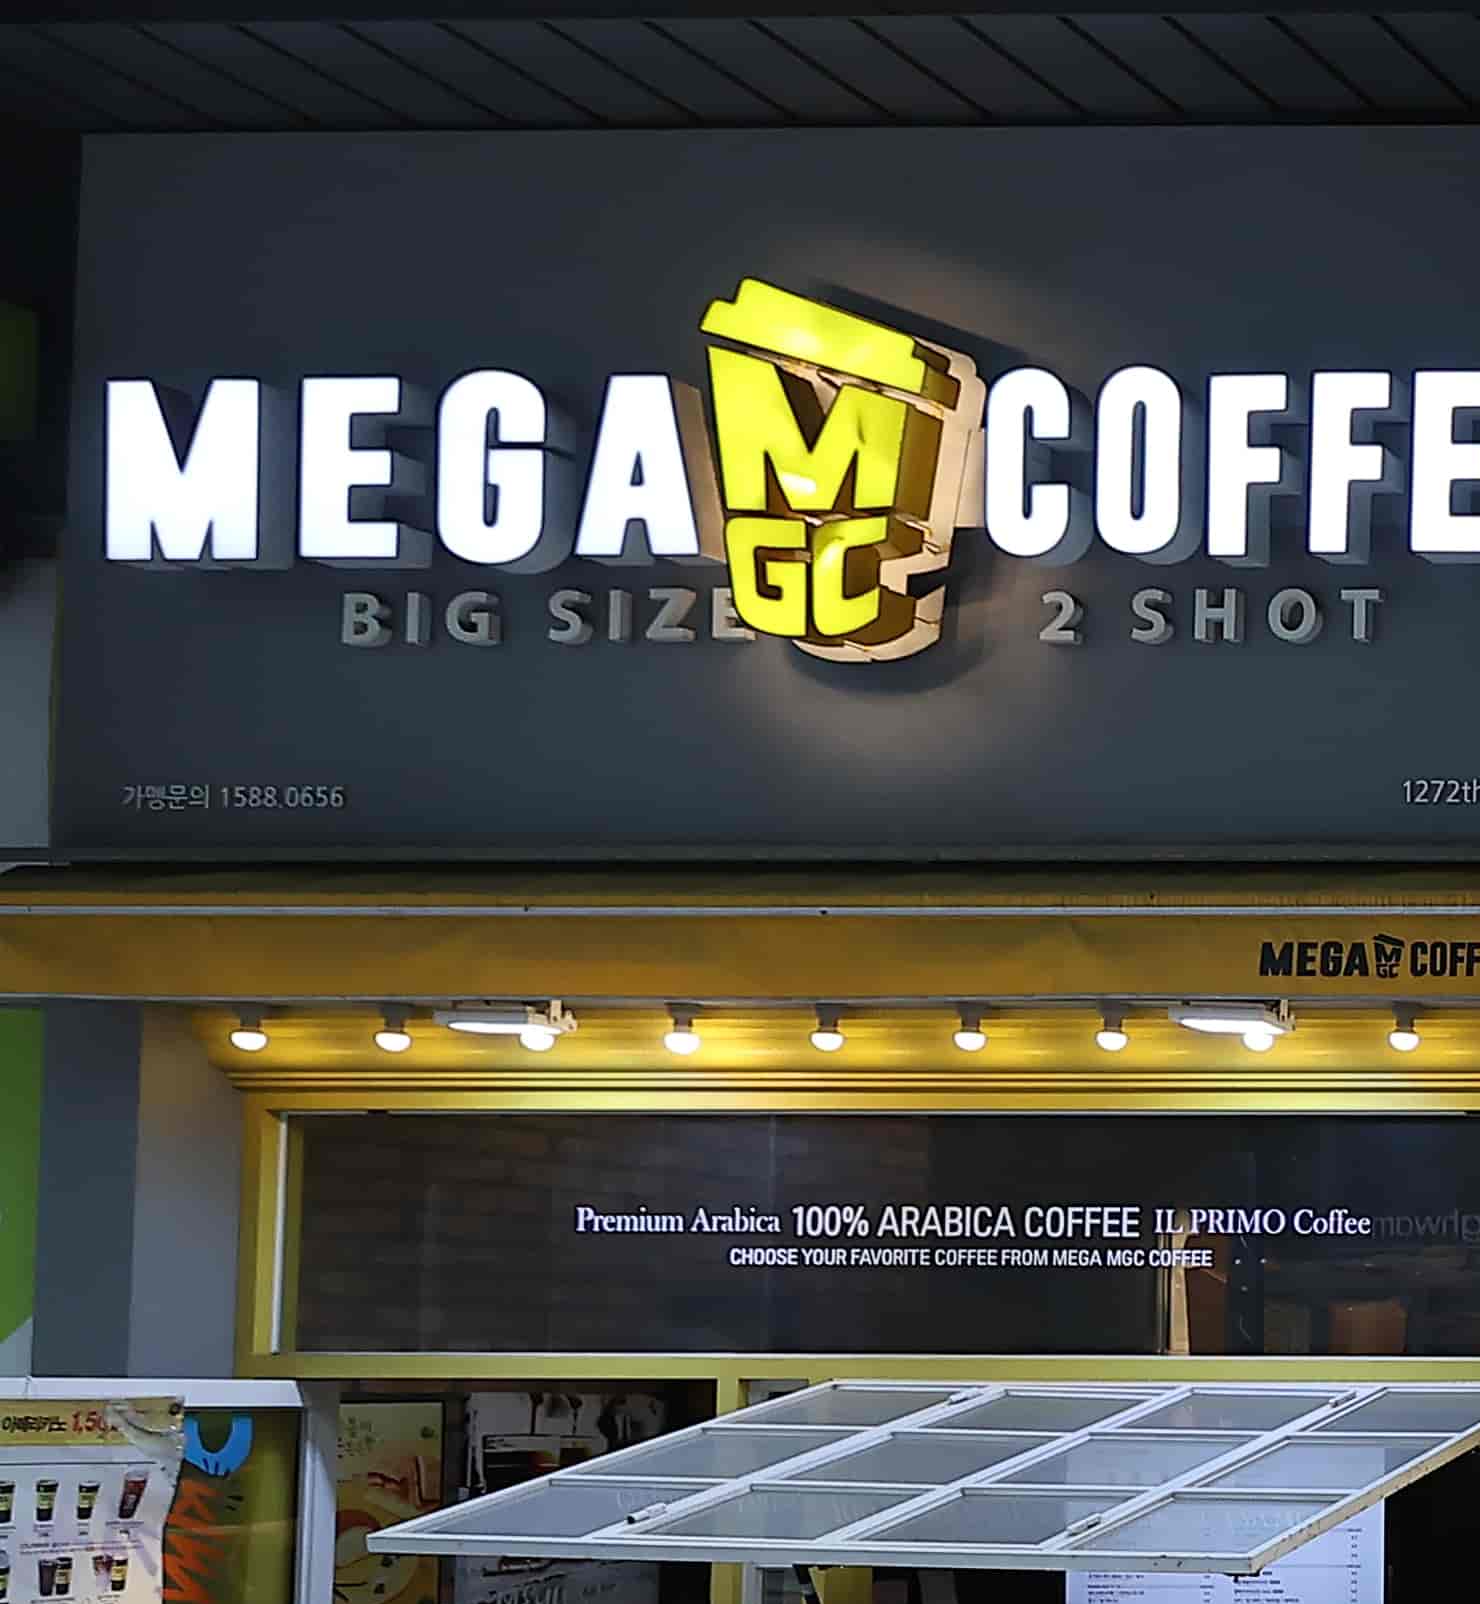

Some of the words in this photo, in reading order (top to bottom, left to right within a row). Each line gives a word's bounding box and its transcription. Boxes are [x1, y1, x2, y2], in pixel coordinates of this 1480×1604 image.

[104, 370, 700, 563] MEGA
[341, 588, 503, 647] BIG
[548, 588, 758, 647] SIZE
[1040, 590, 1086, 646] 2
[1129, 588, 1386, 646] SHOT
[120, 784, 210, 810] 가맹문의
[220, 786, 345, 808] 1588.0656
[1260, 942, 1369, 977] MEGA
[575, 1207, 683, 1234] Premium
[690, 1207, 781, 1233] Arabica
[791, 1206, 867, 1238] 100%
[877, 1206, 1016, 1238] ARABICA
[1024, 1206, 1140, 1238] COFFEE
[1153, 1209, 1186, 1234] IL
[1190, 1209, 1286, 1235] PRIMO
[1294, 1207, 1371, 1235] Coffee
[729, 1248, 798, 1267] CHOOSE
[801, 1248, 847, 1267] YOUR
[850, 1248, 931, 1267] FAVORITE
[934, 1248, 998, 1267] COFFEE
[1001, 1248, 1049, 1267] FROM
[1052, 1248, 1102, 1267] MEGA
[1106, 1249, 1144, 1267] MGC
[1149, 1249, 1212, 1267] COFFEE
